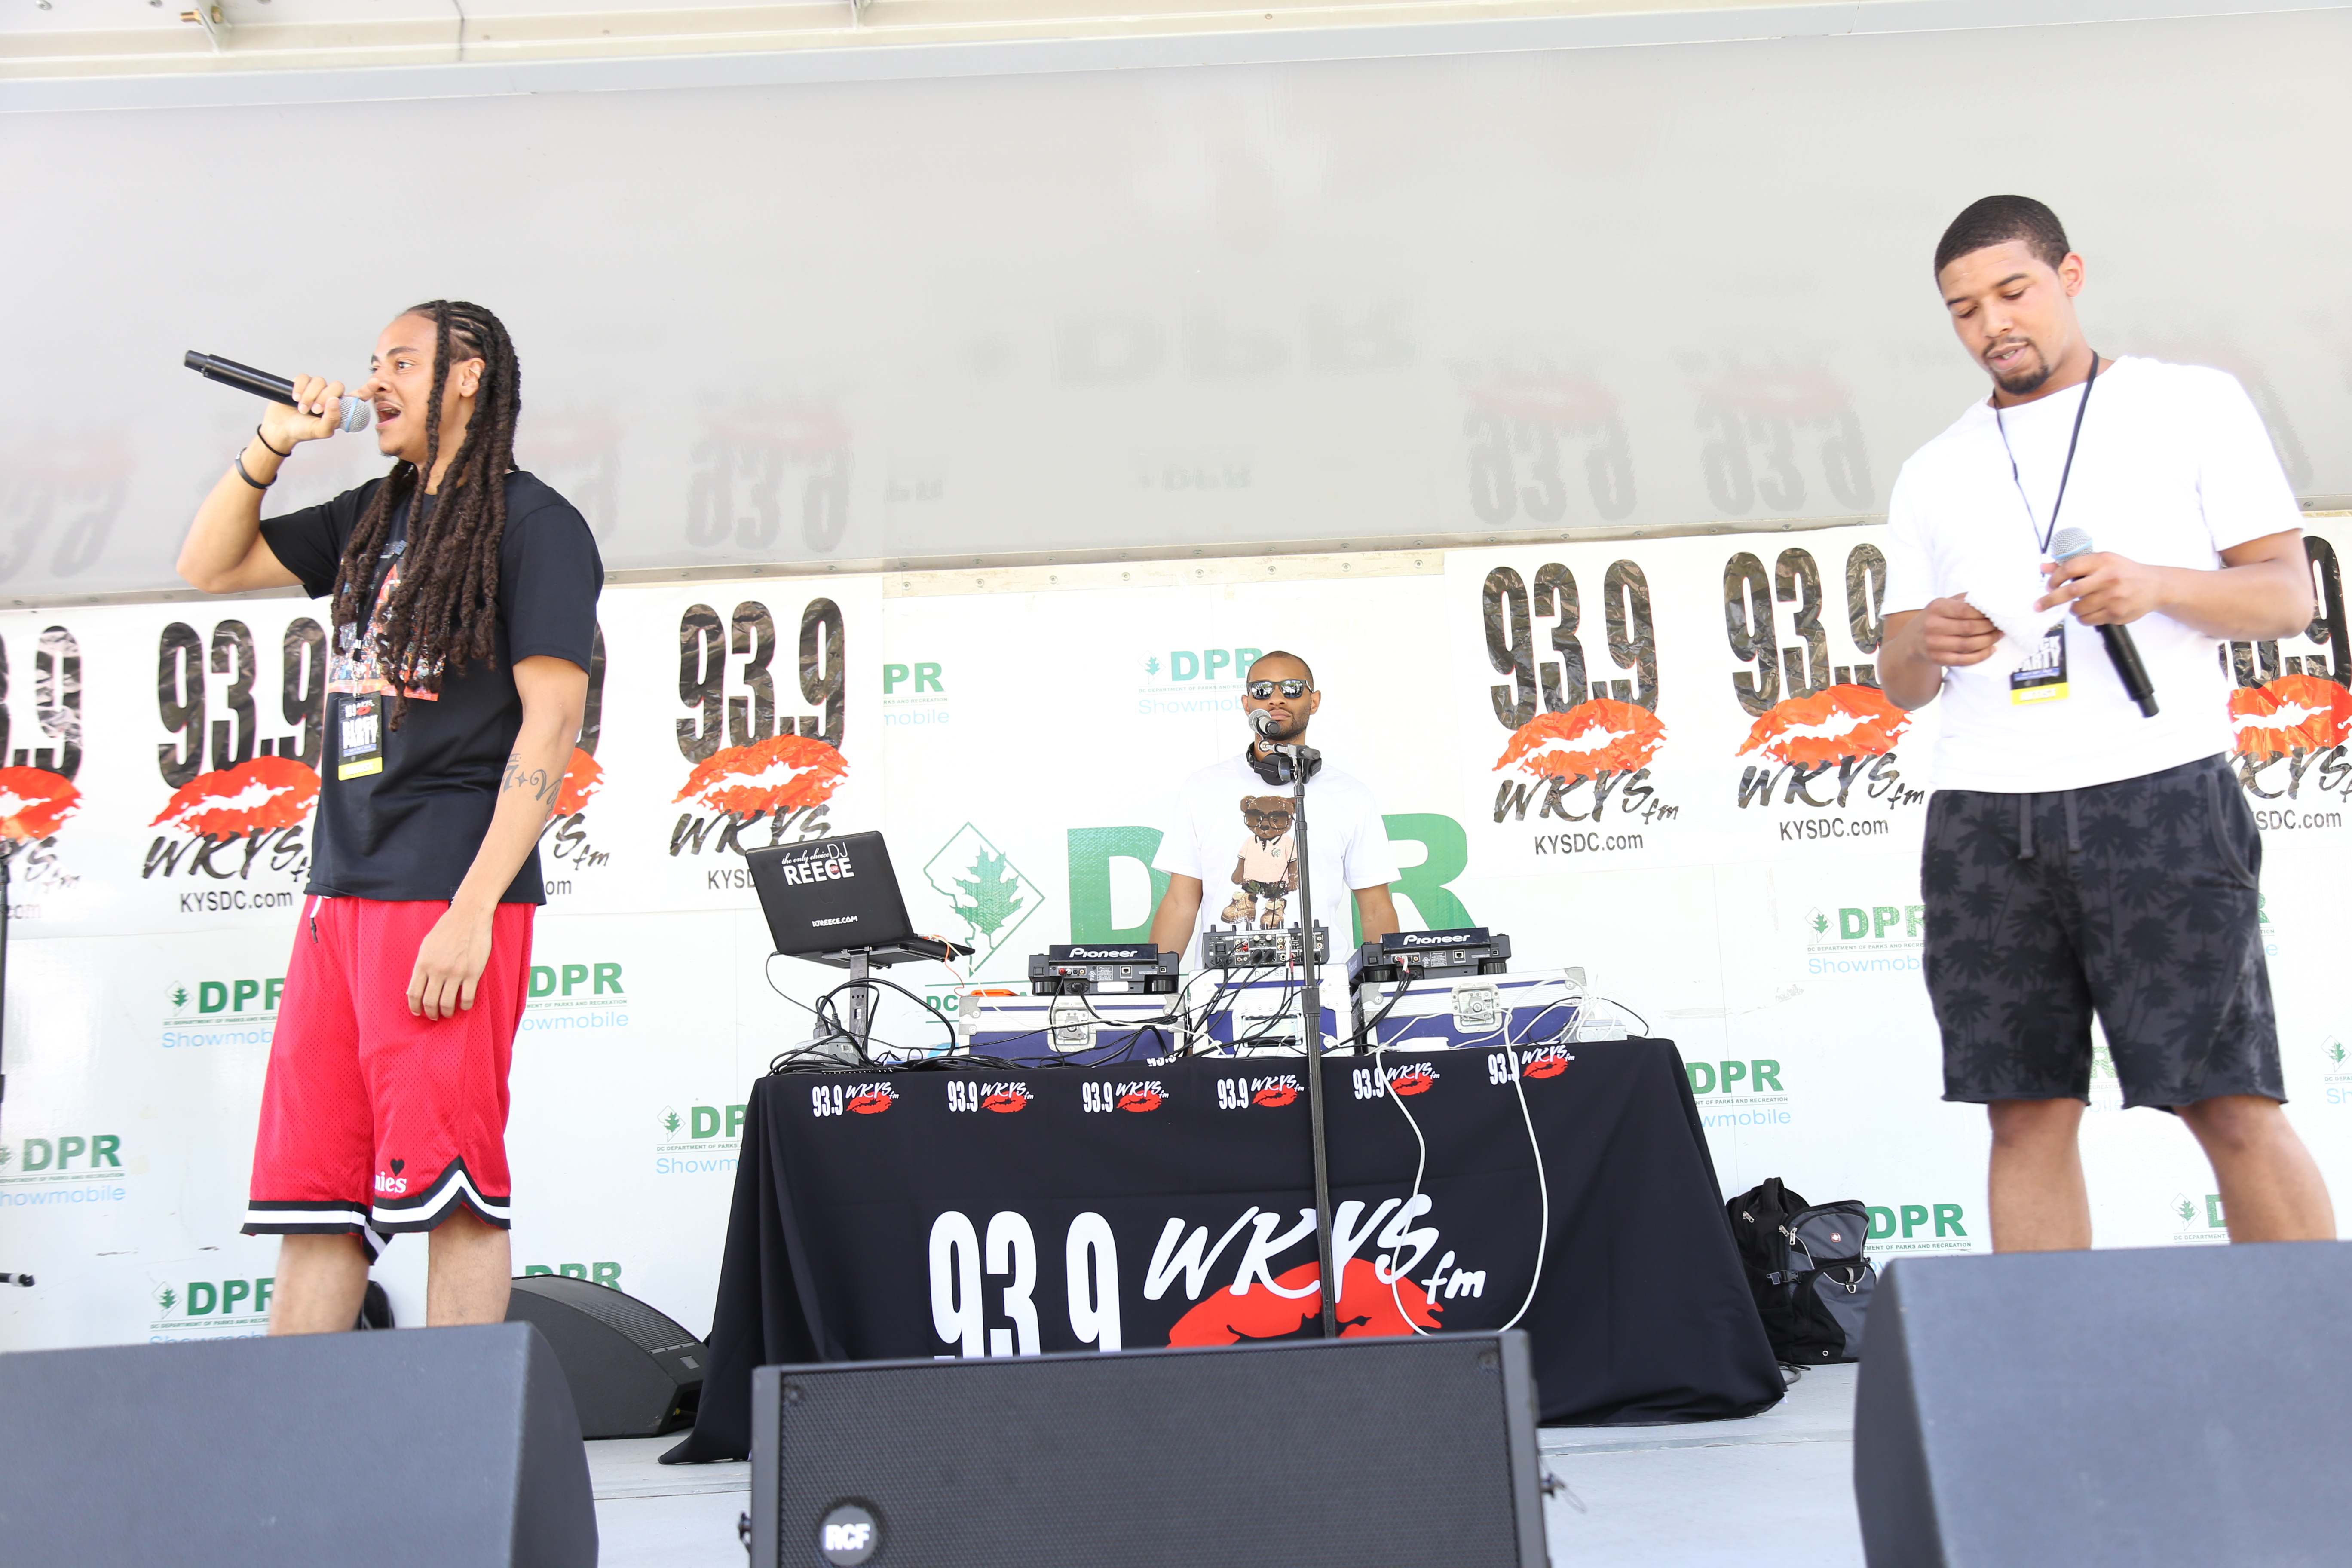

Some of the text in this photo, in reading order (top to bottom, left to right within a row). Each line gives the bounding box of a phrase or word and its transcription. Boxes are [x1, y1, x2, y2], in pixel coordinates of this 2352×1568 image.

[1482, 559, 1658, 730] 93.9
[1724, 543, 1887, 717] 93.9
[676, 597, 845, 764] 93.9
[883, 662, 945, 694] PR
[1171, 648, 1263, 681] DPR
[159, 617, 328, 789] 93.9
[883, 709, 949, 726] mobile
[1139, 695, 1245, 714] Showmob
[1738, 753, 1924, 809] WKYS fm
[2231, 744, 2352, 800] KYS
[1494, 768, 1679, 825] WKYS fm
[670, 804, 831, 856] WKYS
[1780, 818, 1889, 841] KYSDC.com
[2252, 809, 2342, 831] SDC.com
[143, 826, 304, 880] WKYS
[573, 844, 610, 870] fm
[781, 842, 848, 864] the only choice DJ
[1534, 832, 1643, 855] KYSDC.com
[783, 857, 855, 886] REECE
[181, 891, 294, 912] KYSDC.com
[812, 915, 858, 927] DJREECE.COM
[1838, 905, 1926, 940] DPR
[1069, 947, 1138, 958] Pioneer
[1403, 934, 1470, 945] Pioneer
[529, 962, 625, 998] DPR
[1255, 969, 1270, 978] DJM
[1808, 955, 1920, 974] Showmob
[199, 978, 286, 1013] DPR
[926, 995, 959, 1012] DC
[519, 1011, 629, 1031] owmobile
[162, 1028, 273, 1048] Showmob
[1521, 1044, 1568, 1065] WKYS
[1565, 1054, 1575, 1062] fm
[1217, 1078, 1249, 1110] 93.9
[1250, 1075, 1297, 1092] WKYS
[1352, 1068, 1385, 1099] 93.9
[1387, 1062, 1433, 1080] WKYS
[1685, 1059, 1785, 1094] DPR
[812, 1082, 900, 1117] 93.9 WKYS fm
[947, 1081, 1034, 1112] 93.9 WKYS fm
[1082, 1081, 1169, 1113] 93.9 WKYS fm
[692, 1104, 748, 1139] DP
[1701, 1109, 1791, 1127] wmobile
[22, 1134, 122, 1171] DPR
[656, 1158, 738, 1174] Showm
[0, 1185, 126, 1206] howmobile
[1865, 1204, 1968, 1239] DPR
[928, 1194, 1486, 1359] 939 WKYS fm
[187, 1277, 275, 1316] DPR
[825, 1523, 871, 1551] RCF
